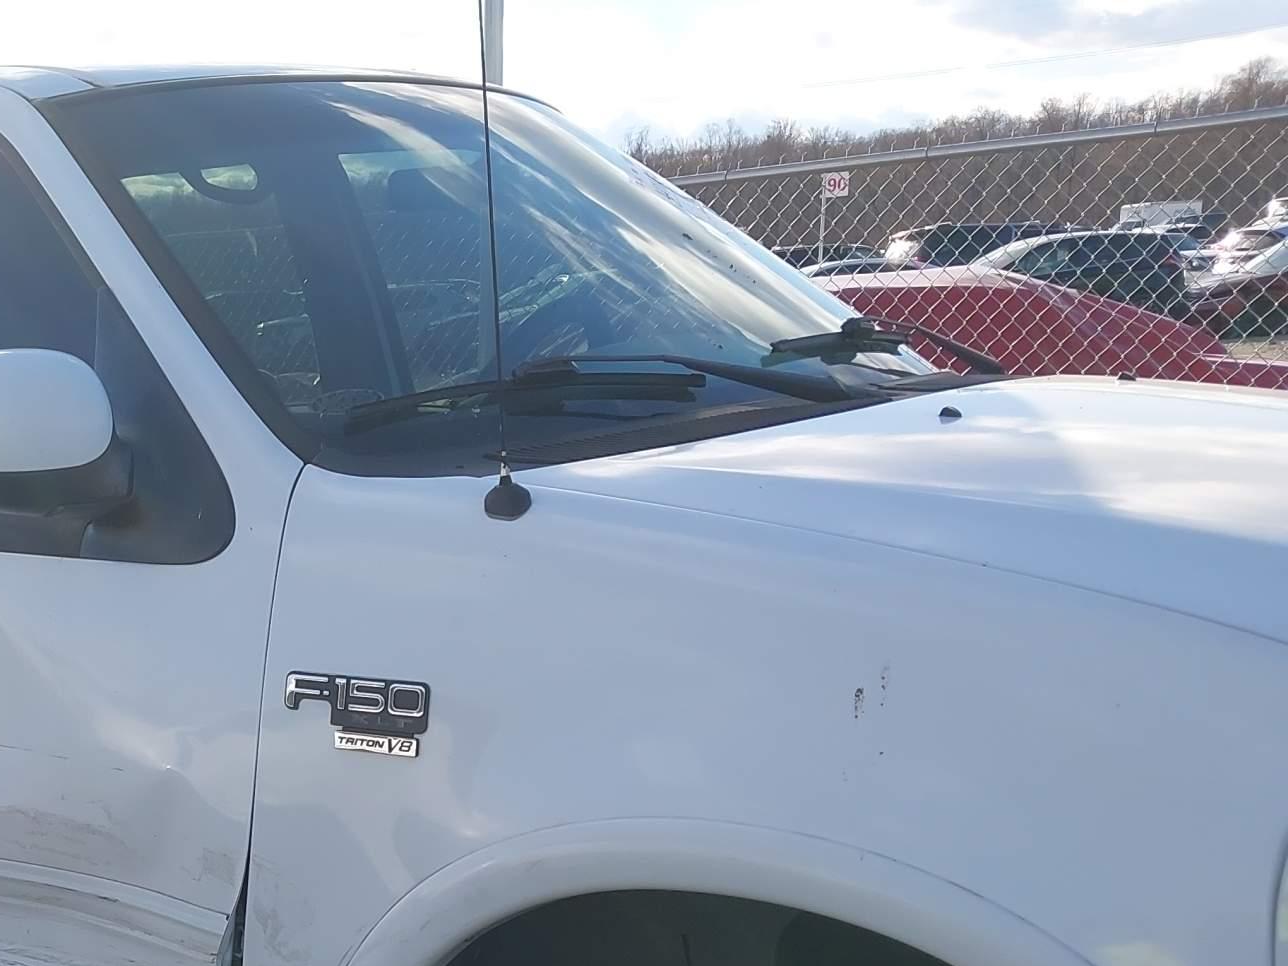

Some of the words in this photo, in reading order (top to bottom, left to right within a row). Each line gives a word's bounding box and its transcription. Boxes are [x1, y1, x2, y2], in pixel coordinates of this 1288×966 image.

[827, 177, 848, 192] 90
[285, 673, 426, 718] F-150
[338, 736, 385, 749] TRITON
[387, 738, 414, 754] V8
